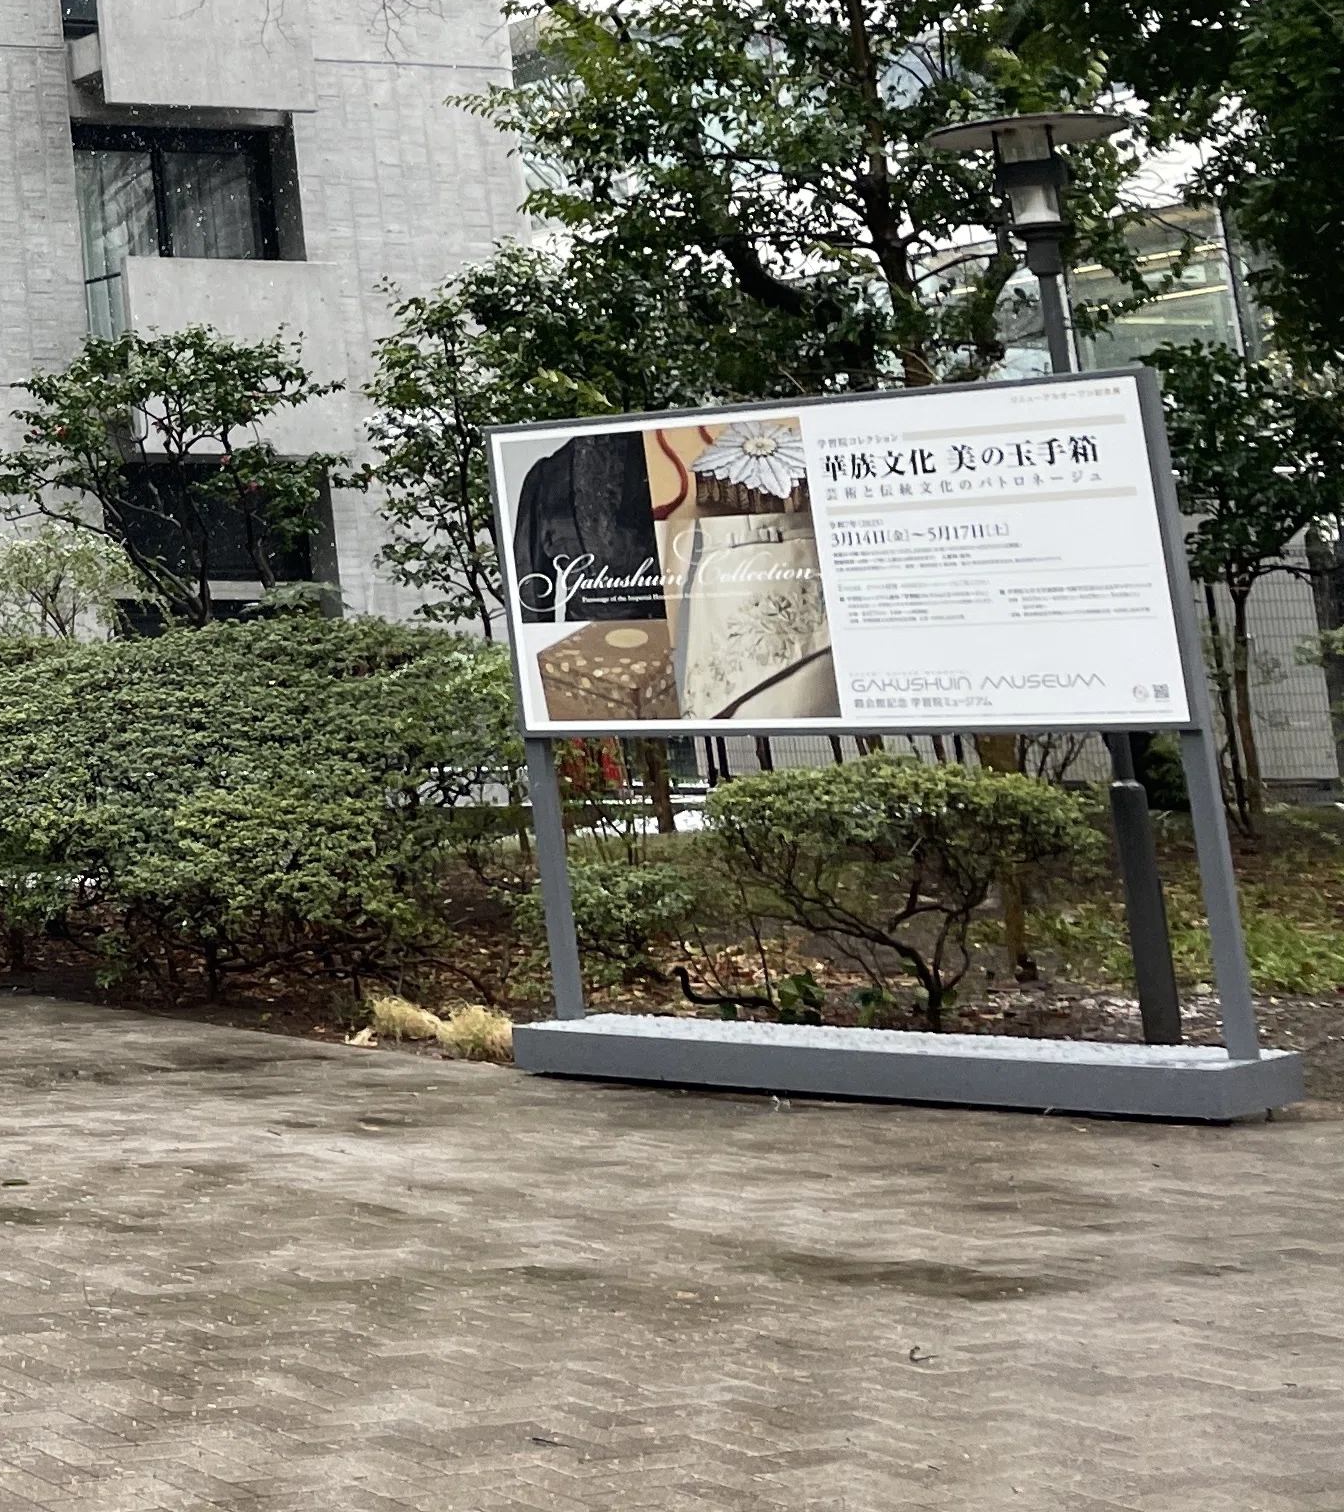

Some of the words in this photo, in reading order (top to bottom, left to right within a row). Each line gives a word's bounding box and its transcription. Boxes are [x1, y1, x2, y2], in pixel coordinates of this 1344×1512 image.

[817, 433, 899, 449] 学習院コレクション
[820, 448, 937, 482] 華族文化
[947, 435, 1099, 474] 美の玉手箱
[826, 470, 1103, 501] 芸術と伝統文化のパトロネージュ
[518, 553, 684, 612] Gakushuin
[673, 530, 822, 584] Collection
[851, 675, 972, 693] GAKUSHUIN
[980, 673, 1106, 691] MUSEUM
